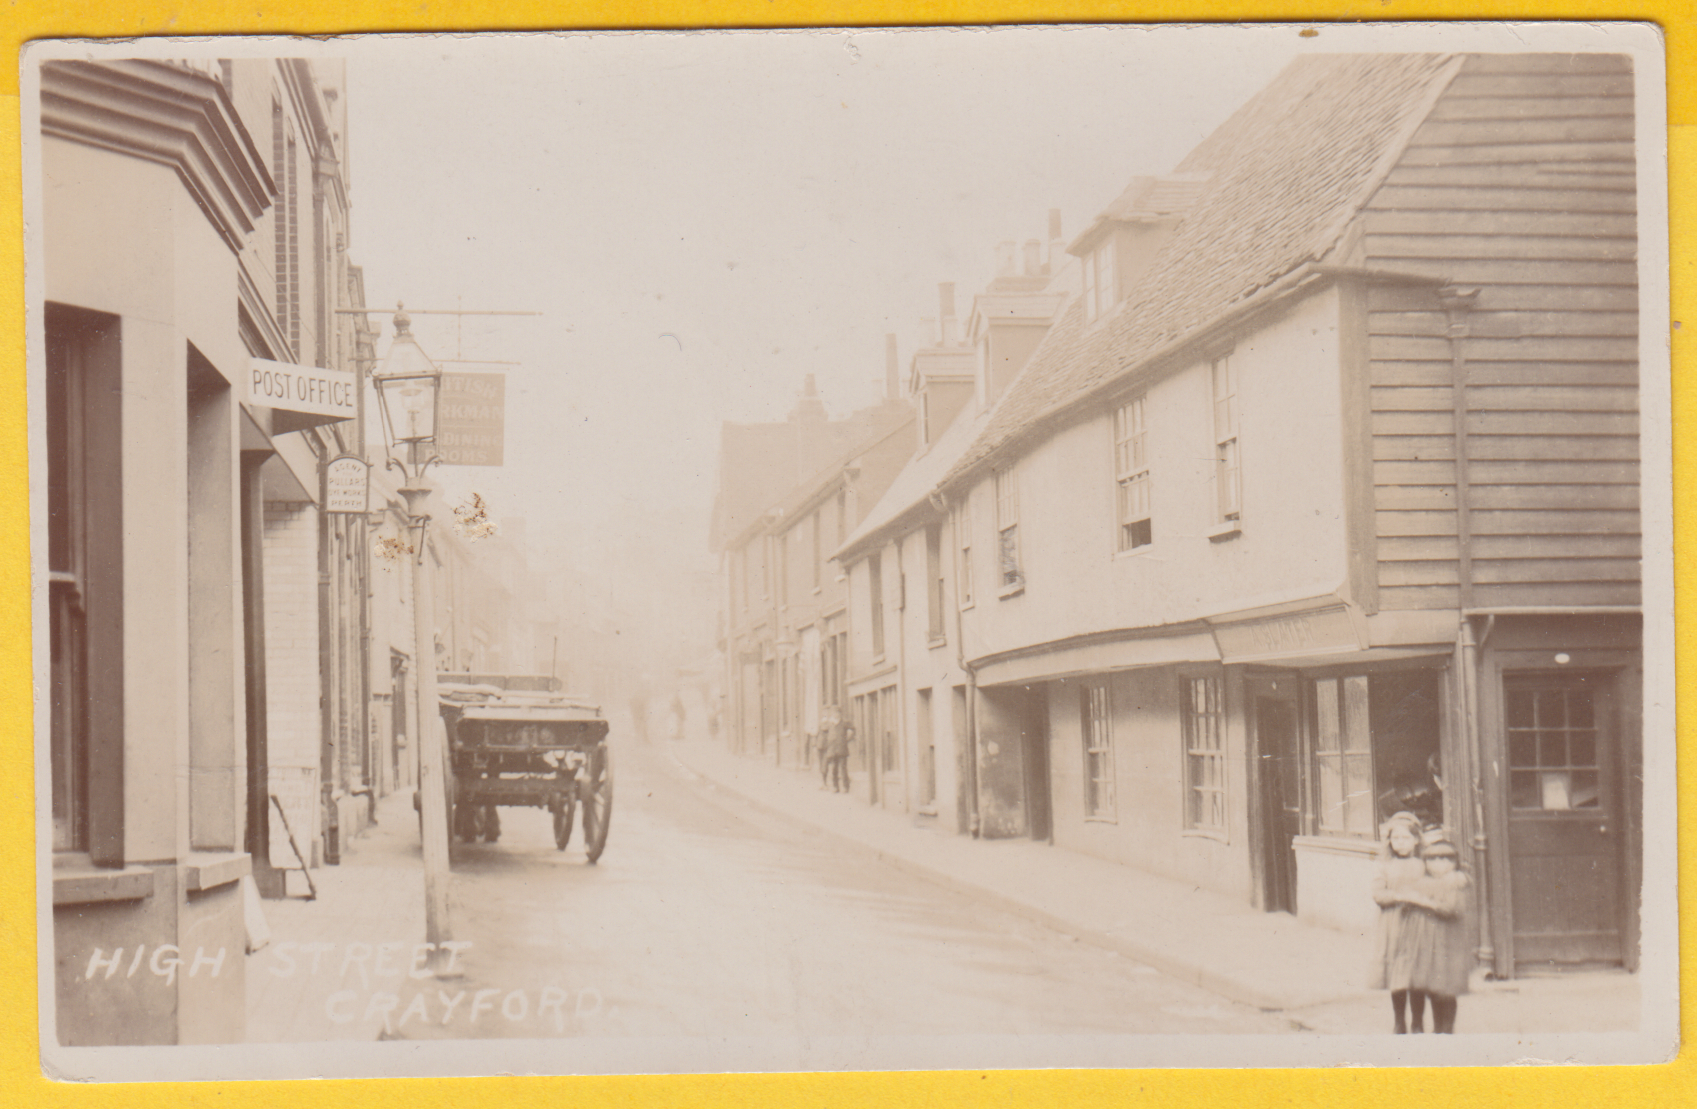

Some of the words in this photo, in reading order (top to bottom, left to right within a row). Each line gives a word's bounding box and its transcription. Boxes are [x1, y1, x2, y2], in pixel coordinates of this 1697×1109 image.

[253, 369, 291, 400] POST
[297, 376, 353, 407] OFFICE
[442, 377, 498, 400] ITISH
